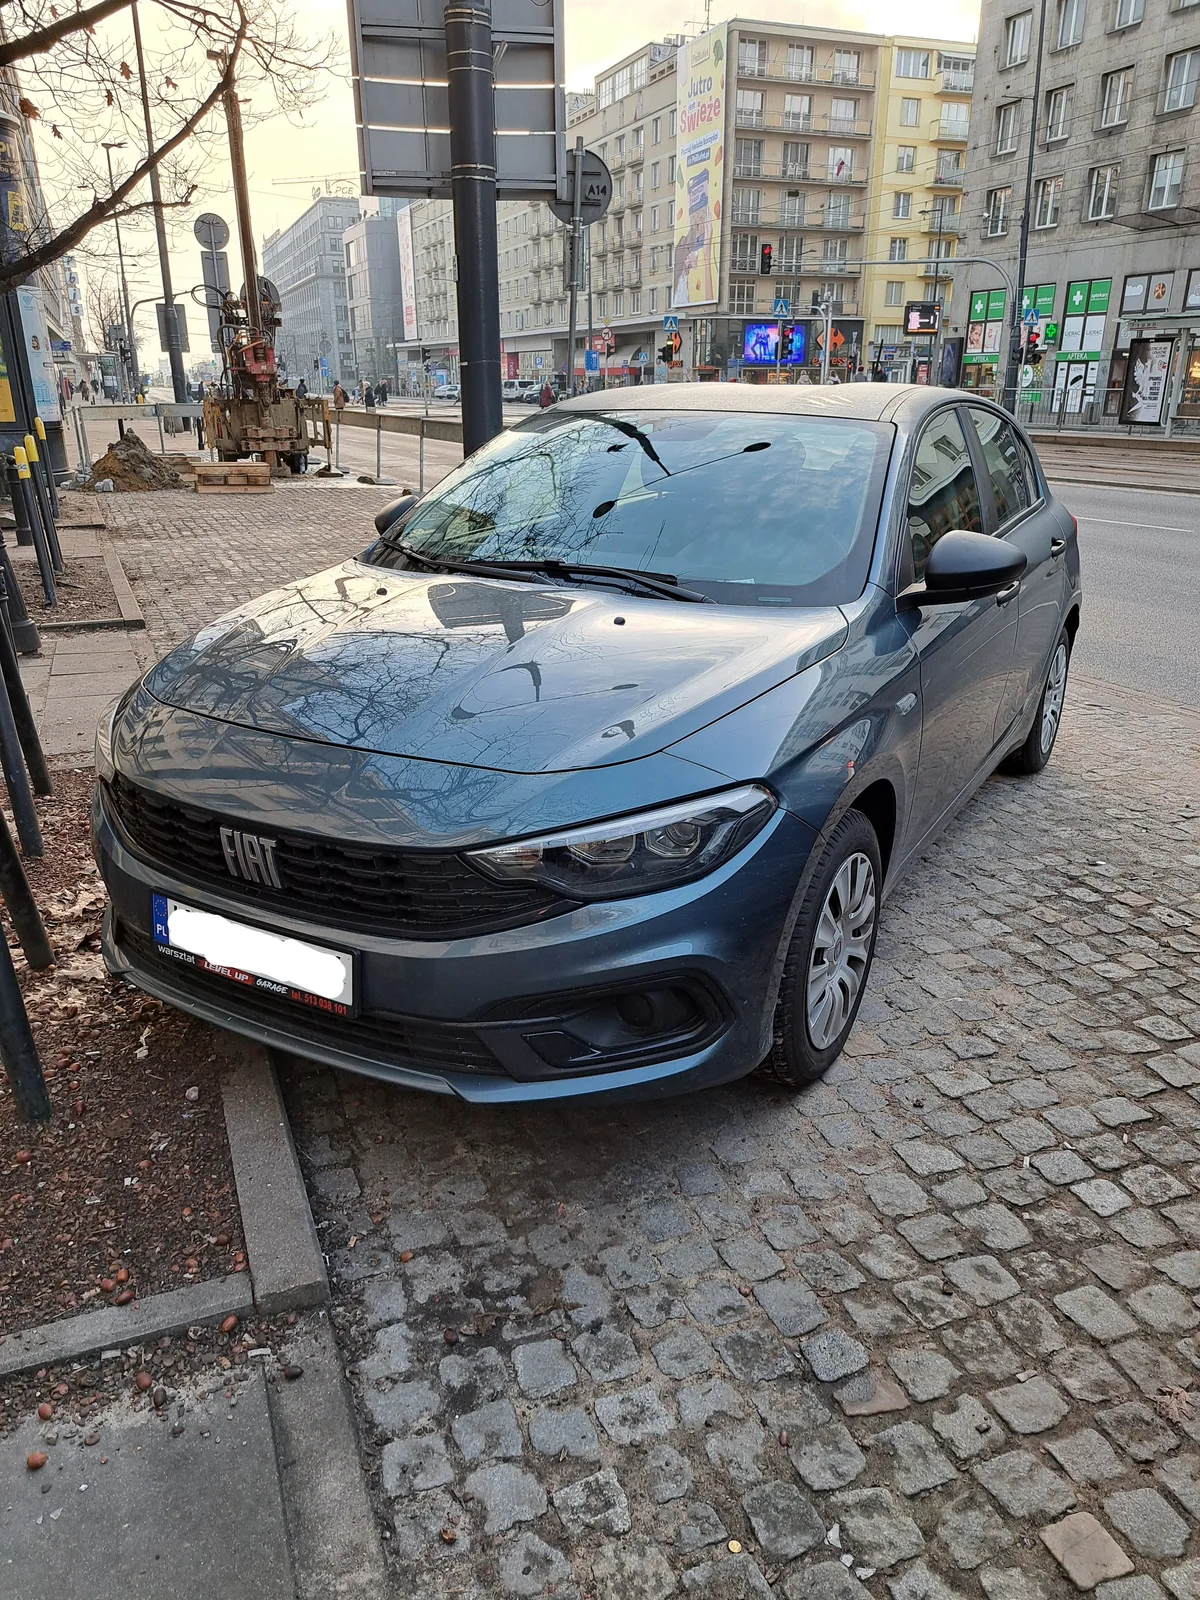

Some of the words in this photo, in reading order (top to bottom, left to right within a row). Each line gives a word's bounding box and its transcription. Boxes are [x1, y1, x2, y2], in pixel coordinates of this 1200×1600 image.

[688, 76, 712, 99] Jutro
[680, 95, 721, 134] Świeże
[335, 186, 354, 195] PGE
[588, 184, 607, 196] A14
[971, 355, 990, 363] APTEKA
[1066, 352, 1088, 360] APTEKA
[219, 826, 282, 889] FIAT
[156, 923, 168, 937] PL
[157, 944, 196, 965] warsztat
[203, 961, 232, 978] LEVEL
[234, 971, 249, 982] UP
[256, 978, 289, 995] GARAGE
[304, 993, 318, 1005] 513
[318, 998, 332, 1011] 038
[333, 1003, 347, 1015] 101
